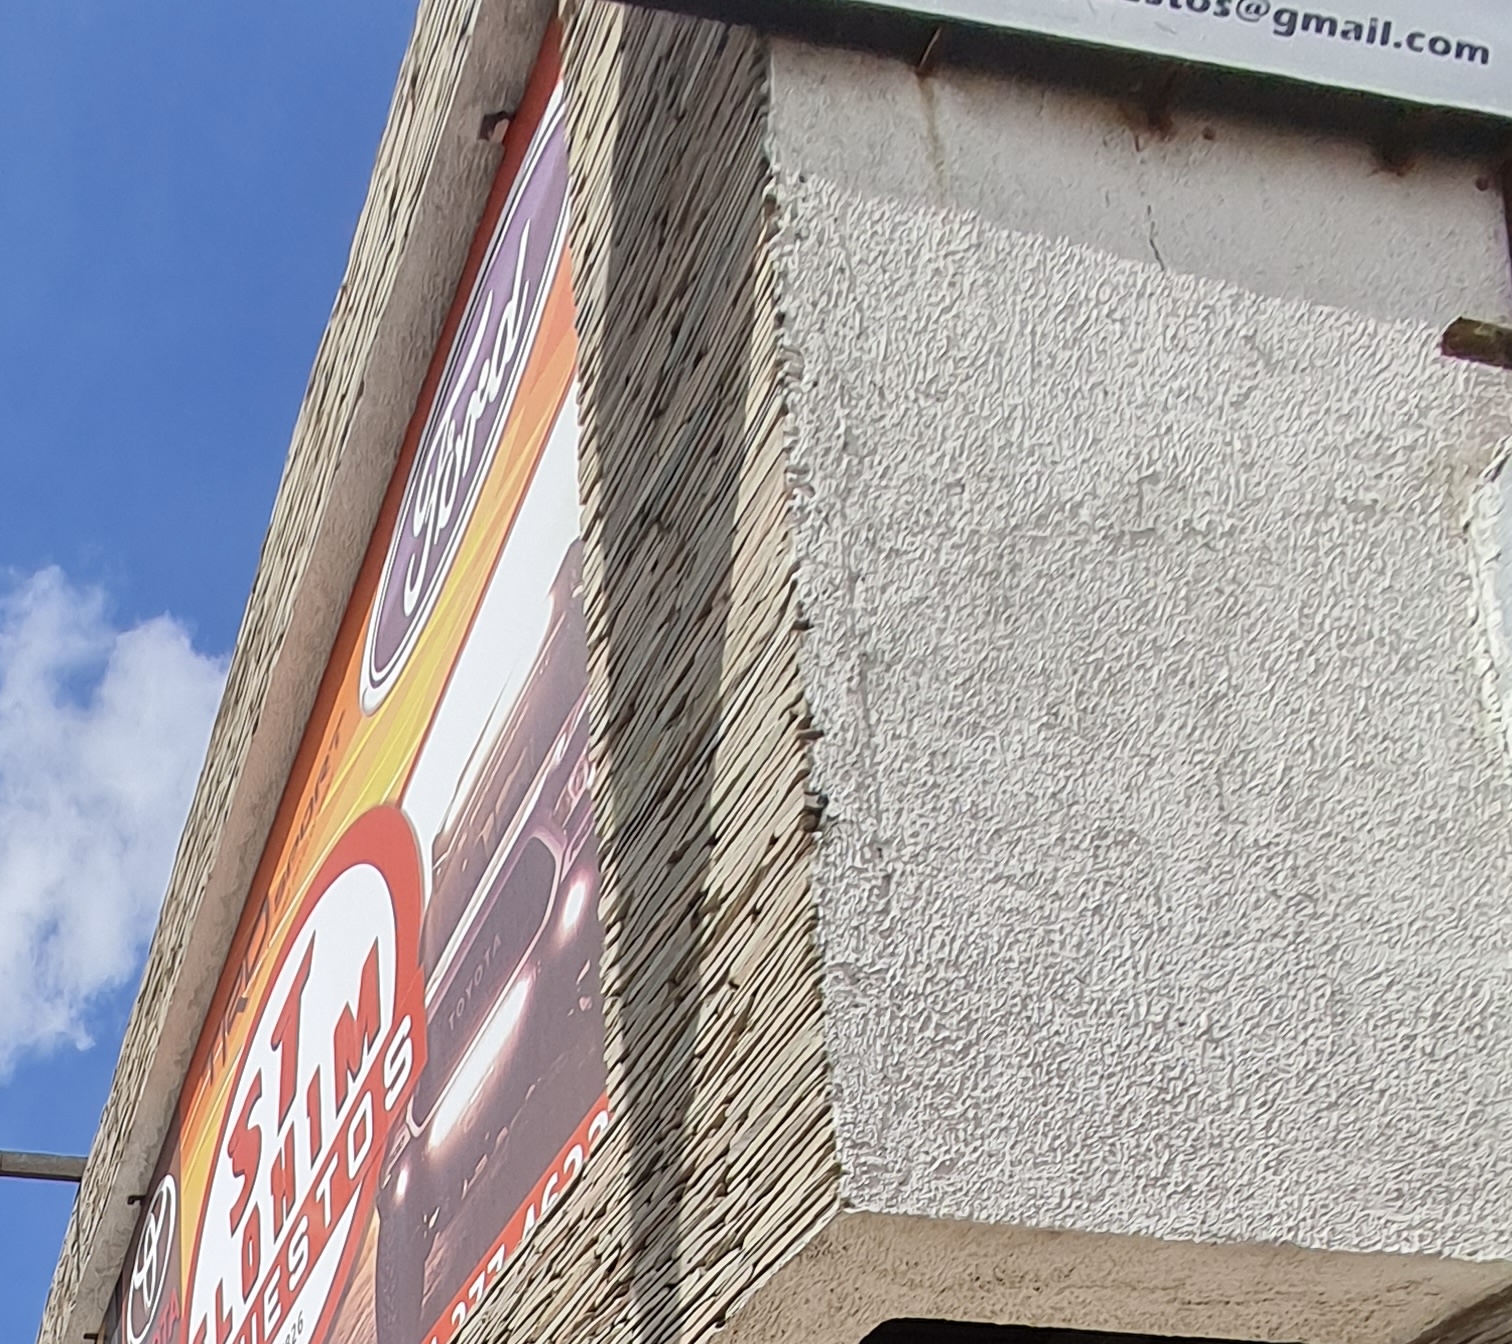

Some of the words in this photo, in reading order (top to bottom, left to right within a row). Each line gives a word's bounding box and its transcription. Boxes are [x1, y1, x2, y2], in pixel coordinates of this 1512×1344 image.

[402, 218, 530, 617] Ford
[229, 930, 316, 1237] ST
[449, 932, 502, 1031] TOYOTA
